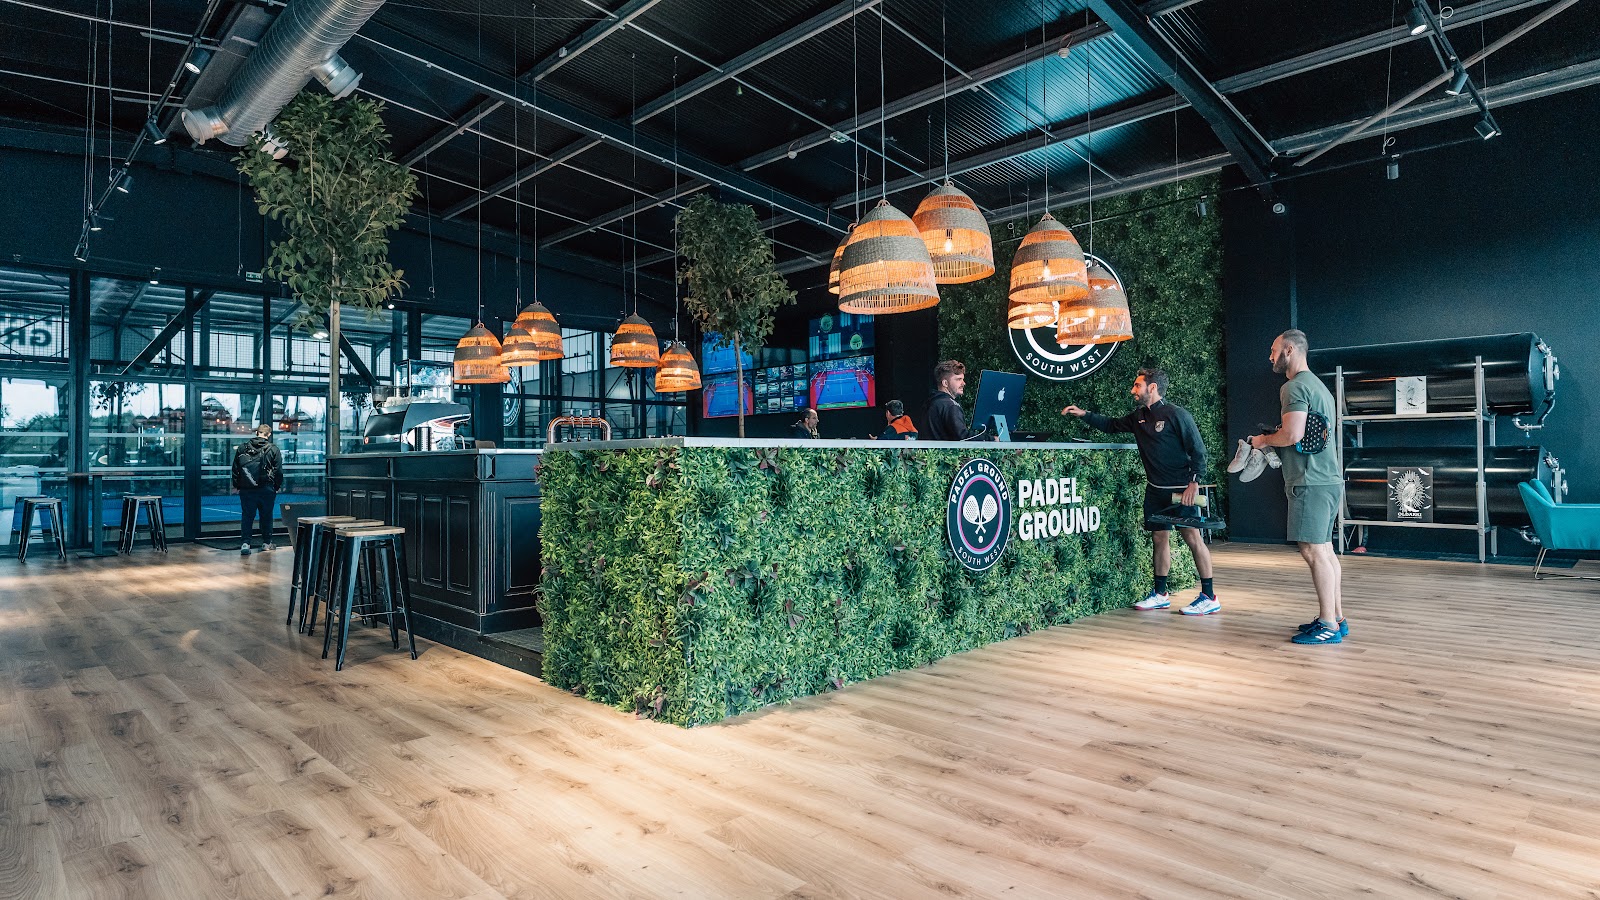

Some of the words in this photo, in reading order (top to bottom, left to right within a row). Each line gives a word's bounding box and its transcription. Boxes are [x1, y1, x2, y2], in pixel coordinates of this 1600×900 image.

[1025, 352, 1064, 374] SOUTH
[1070, 349, 1102, 373] WEST
[951, 465, 975, 504] PADEL
[977, 462, 1008, 501] GROUND
[1018, 477, 1082, 507] PADEL
[1018, 506, 1101, 541] GROUND
[957, 546, 981, 566] SOUTH
[984, 544, 1001, 564] WEST
